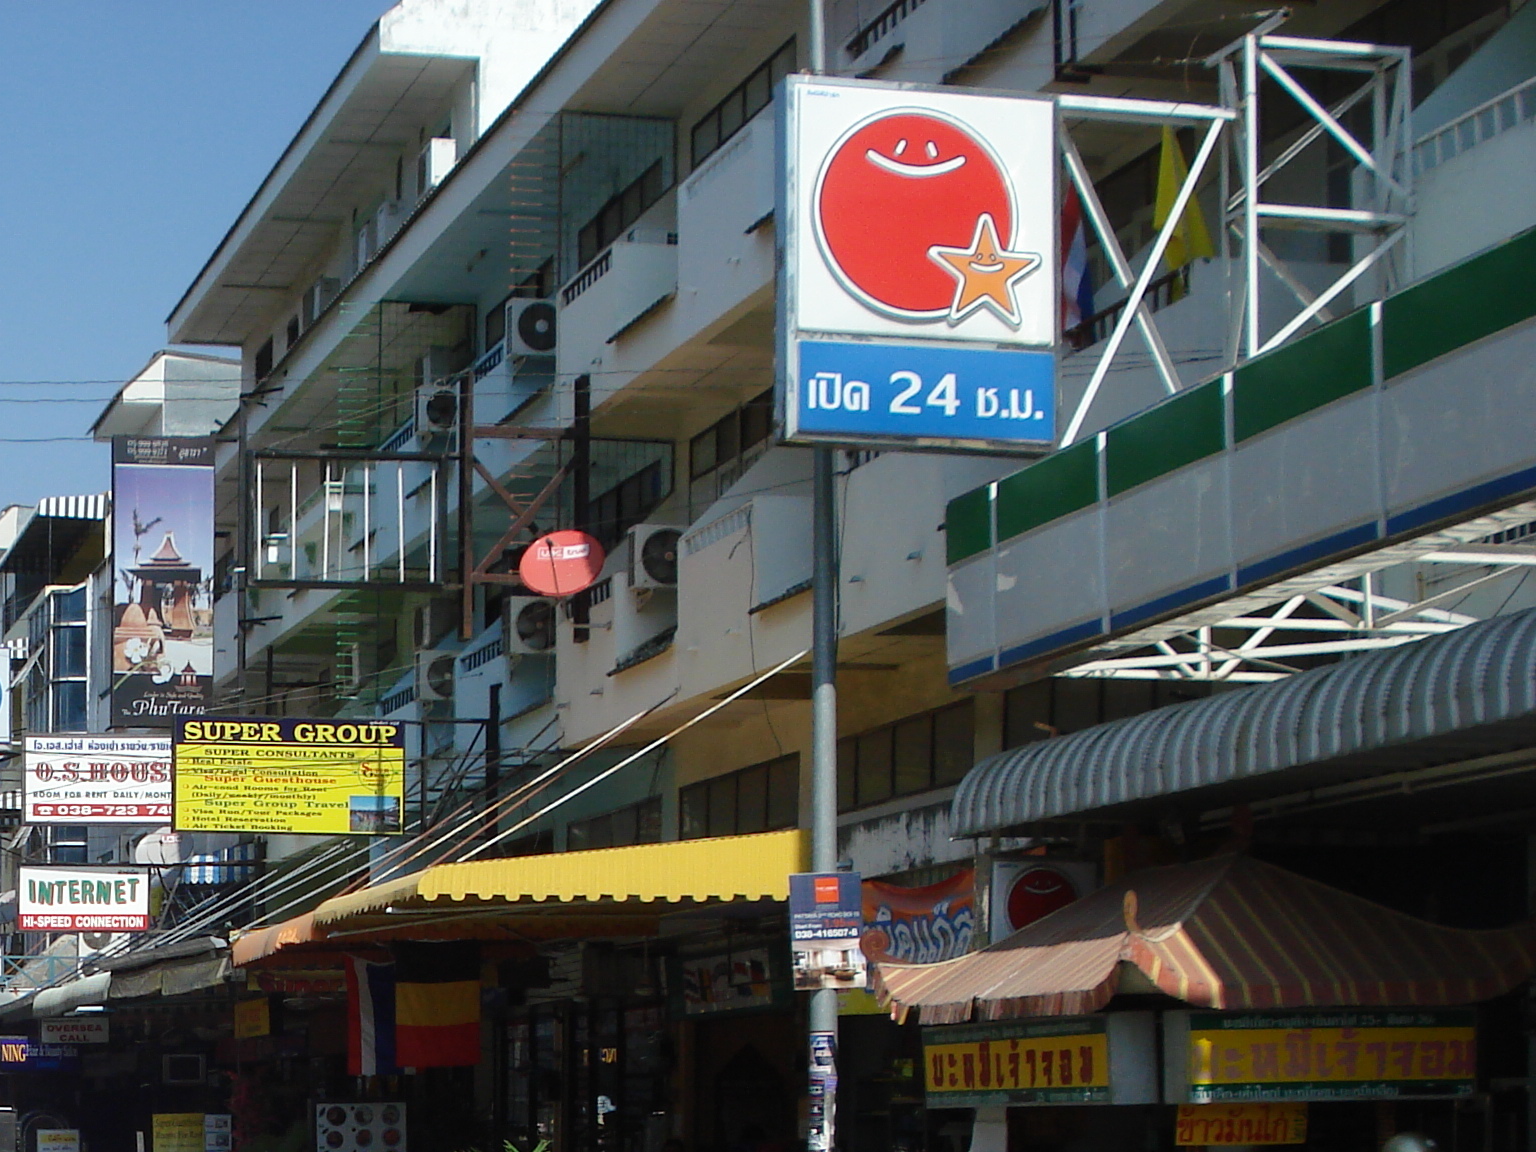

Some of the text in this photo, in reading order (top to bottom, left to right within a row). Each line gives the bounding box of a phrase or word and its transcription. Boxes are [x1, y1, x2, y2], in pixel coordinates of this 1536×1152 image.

[808, 371, 870, 411] เปิด
[889, 370, 961, 416] 24
[184, 721, 397, 744] SUPER GROUP
[204, 749, 355, 758] SUPER CONSULTANTS
[35, 762, 172, 782] O.S.HOUS
[204, 775, 337, 785] Super Guesthouse
[33, 791, 61, 799] ROOM
[64, 791, 81, 799] FOR
[85, 791, 107, 799] RENT
[204, 799, 349, 809] Super Group Travel
[57, 805, 138, 815] 038-723
[28, 878, 140, 906] INTERNET
[23, 916, 144, 927] HI-SPEED CONNECTION
[47, 1024, 103, 1032] OVERSEA
[59, 1034, 89, 1042] CALL
[1, 1044, 26, 1062] NING
